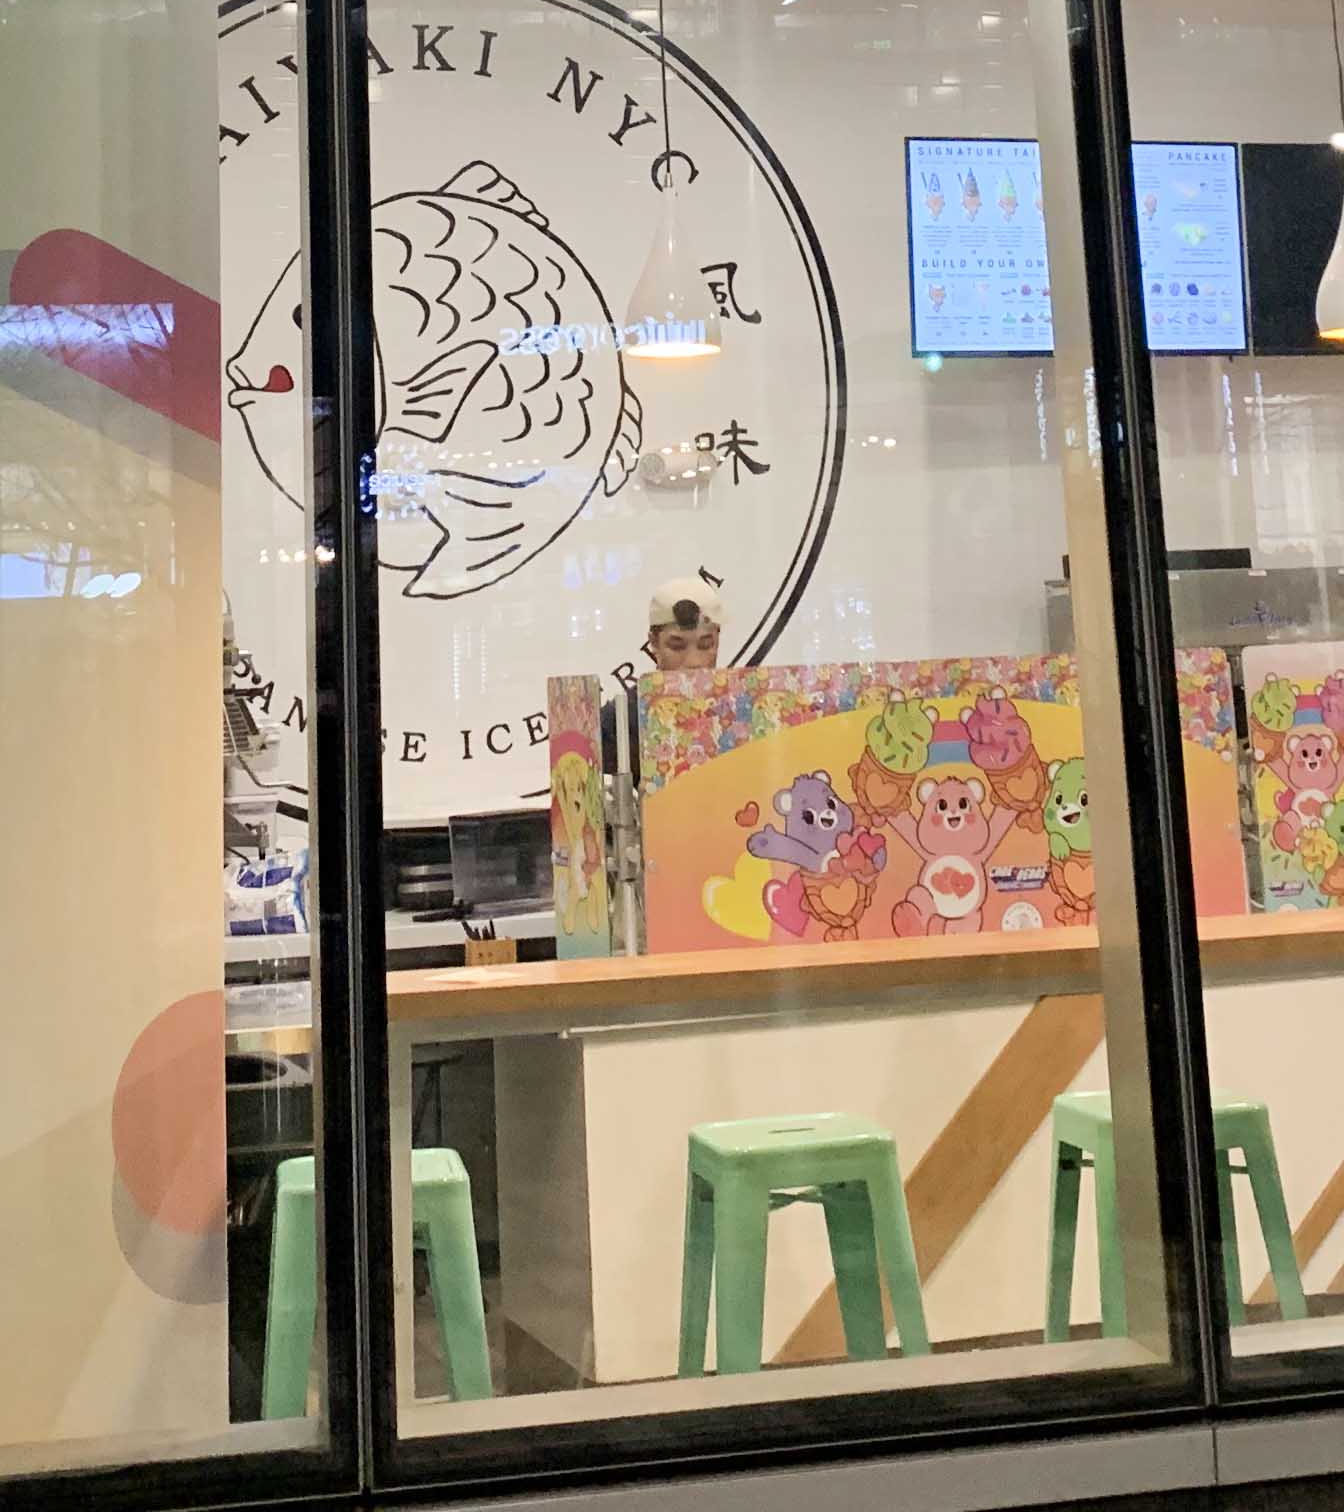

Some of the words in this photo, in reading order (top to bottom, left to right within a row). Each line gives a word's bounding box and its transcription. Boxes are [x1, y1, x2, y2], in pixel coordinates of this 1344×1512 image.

[547, 56, 700, 193] NYC
[917, 146, 1003, 158] SIGNATURE
[921, 258, 968, 269] BUILD
[976, 258, 1017, 269] YOUR
[459, 712, 550, 761] ICE
